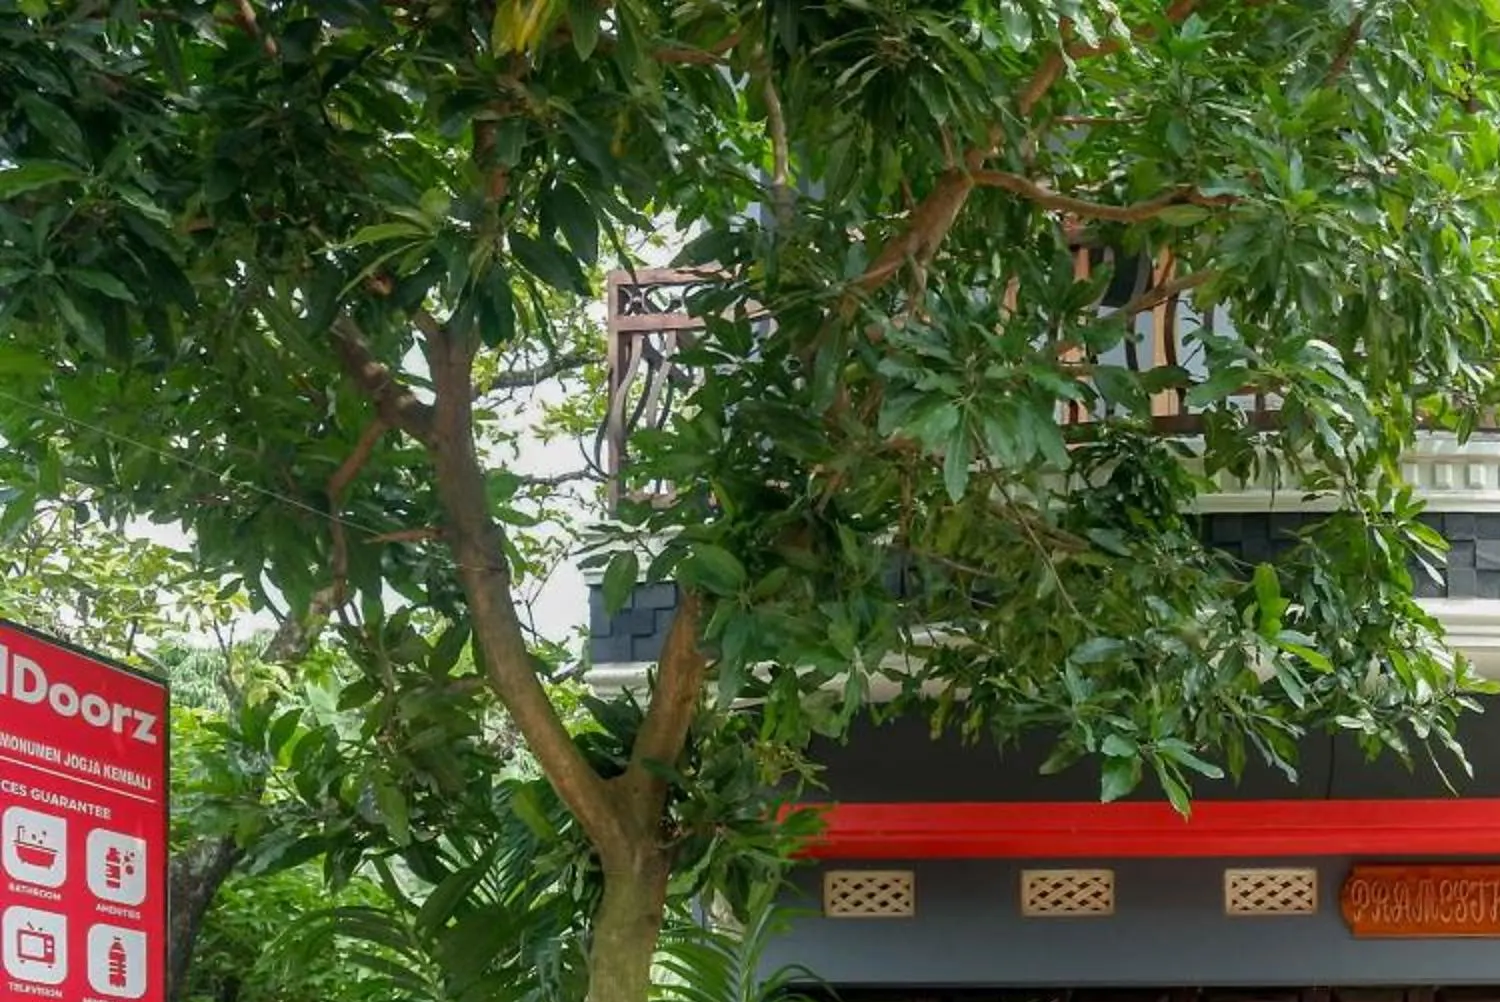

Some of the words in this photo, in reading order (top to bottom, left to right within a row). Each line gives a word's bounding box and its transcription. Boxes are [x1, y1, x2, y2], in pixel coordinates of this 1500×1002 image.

[0, 731, 61, 764] MONUMEN
[63, 751, 101, 776] JOGJA
[103, 763, 152, 791] KEMBALI
[30, 787, 112, 821] GUARANTEE
